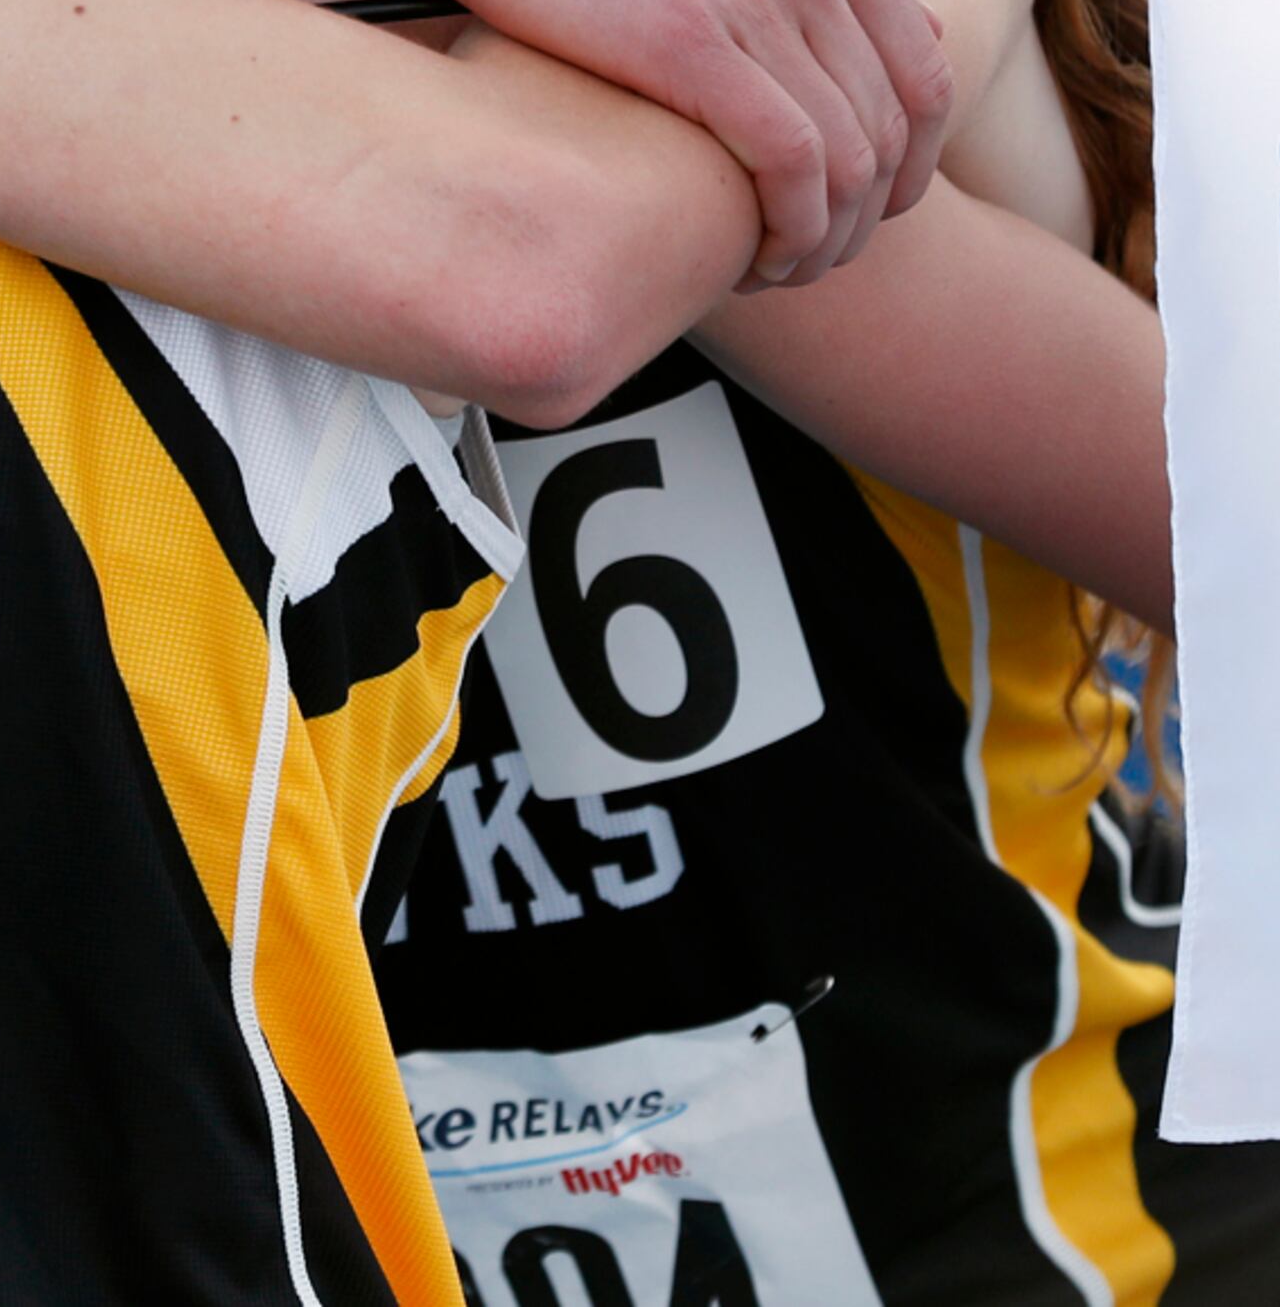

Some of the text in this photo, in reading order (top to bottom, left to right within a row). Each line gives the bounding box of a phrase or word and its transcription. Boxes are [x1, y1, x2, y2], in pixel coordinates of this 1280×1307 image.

[527, 437, 740, 764] 6
[383, 750, 686, 945] KS
[410, 1090, 665, 1154] ke RELAYS
